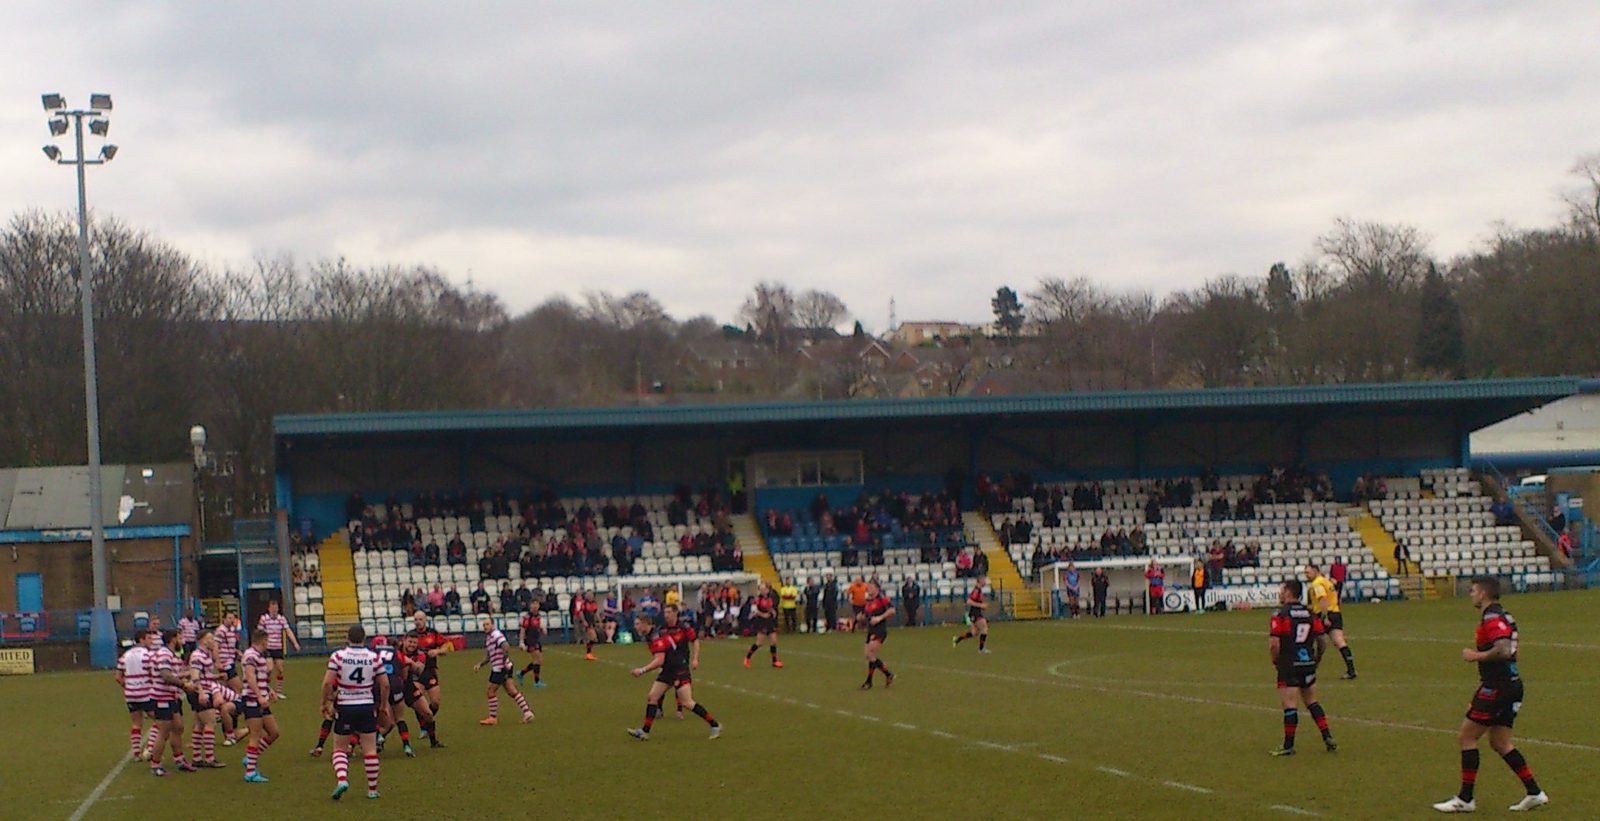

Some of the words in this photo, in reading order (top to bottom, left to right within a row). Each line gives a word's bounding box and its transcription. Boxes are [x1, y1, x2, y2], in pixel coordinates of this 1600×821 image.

[1206, 591, 1243, 604] illiams
[1246, 590, 1257, 601] &
[1295, 622, 1311, 644] 9
[342, 658, 373, 666] HOLMES
[348, 666, 365, 685] 4
